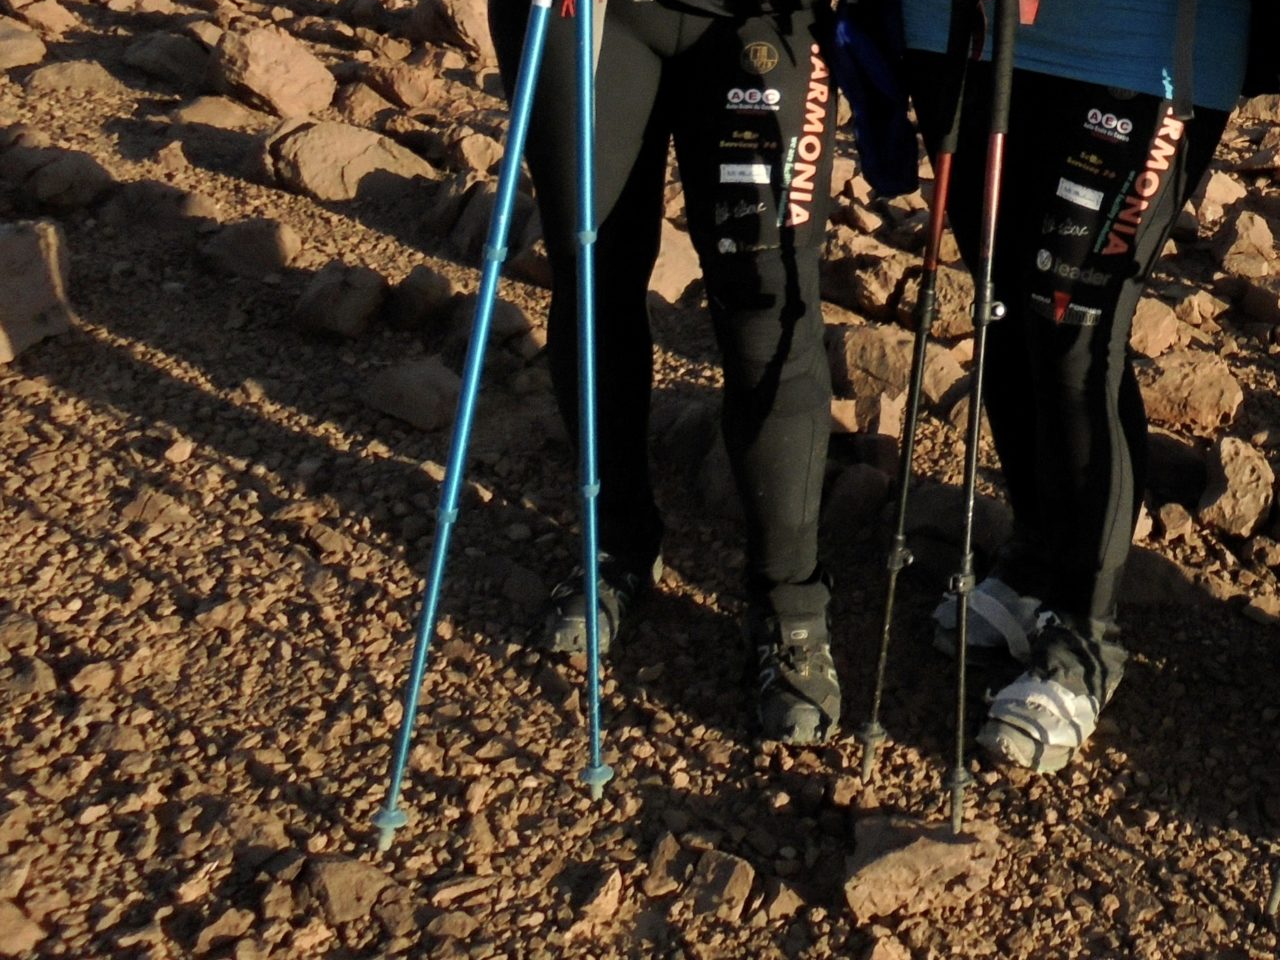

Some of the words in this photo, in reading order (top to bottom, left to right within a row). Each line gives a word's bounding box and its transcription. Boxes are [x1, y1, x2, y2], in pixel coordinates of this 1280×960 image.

[729, 90, 779, 103] AEC
[1089, 110, 1131, 132] AEC
[787, 57, 829, 226] ARMONIA
[1102, 115, 1184, 256] RMONIA
[1053, 257, 1113, 286] leader
